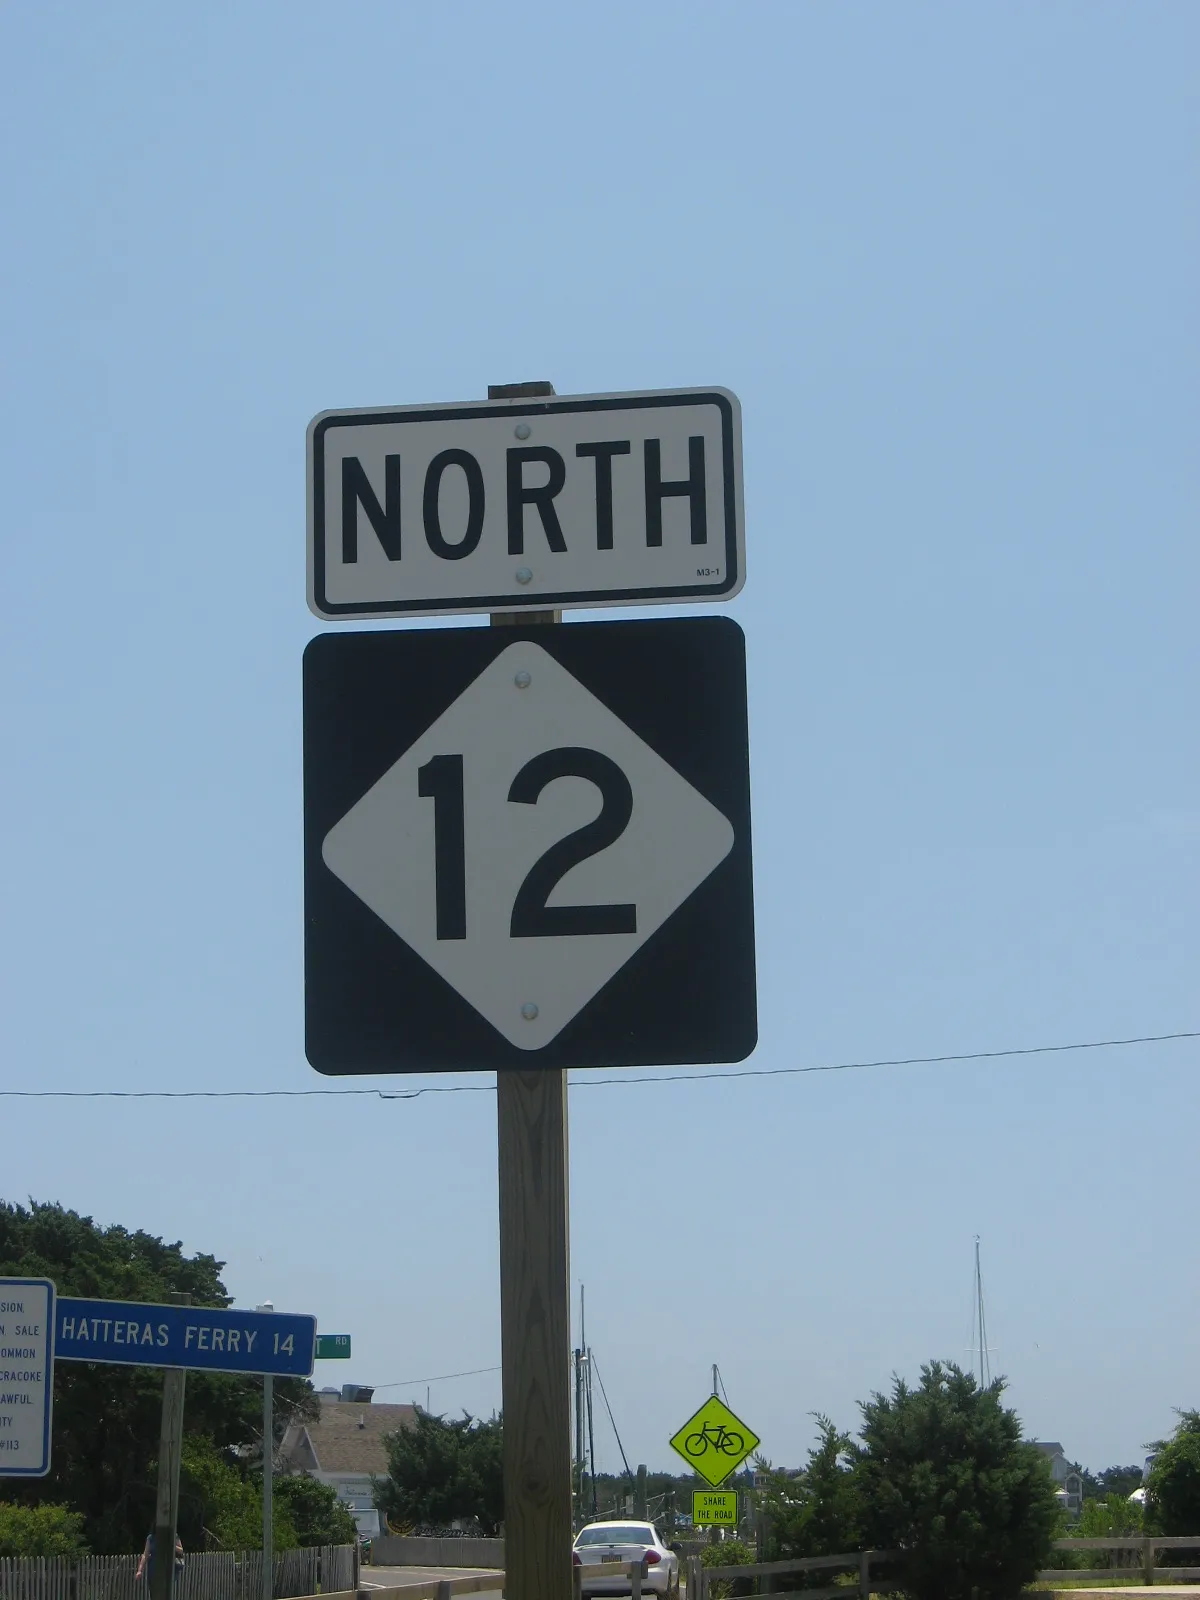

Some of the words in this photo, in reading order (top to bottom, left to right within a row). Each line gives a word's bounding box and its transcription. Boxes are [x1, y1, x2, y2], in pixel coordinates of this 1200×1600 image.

[342, 436, 708, 564] NORTH
[696, 568, 720, 577] M3-1
[417, 746, 637, 941] 12
[15, 1325, 40, 1336] SALE
[62, 1317, 169, 1347] HATTERAS
[184, 1326, 258, 1353] FERRY
[273, 1333, 294, 1356] 14
[335, 1336, 347, 1345] RD
[1, 1347, 36, 1358] OMMON
[703, 1496, 726, 1506] SHARE
[698, 1510, 710, 1519] THE
[714, 1510, 733, 1519] ROAD
